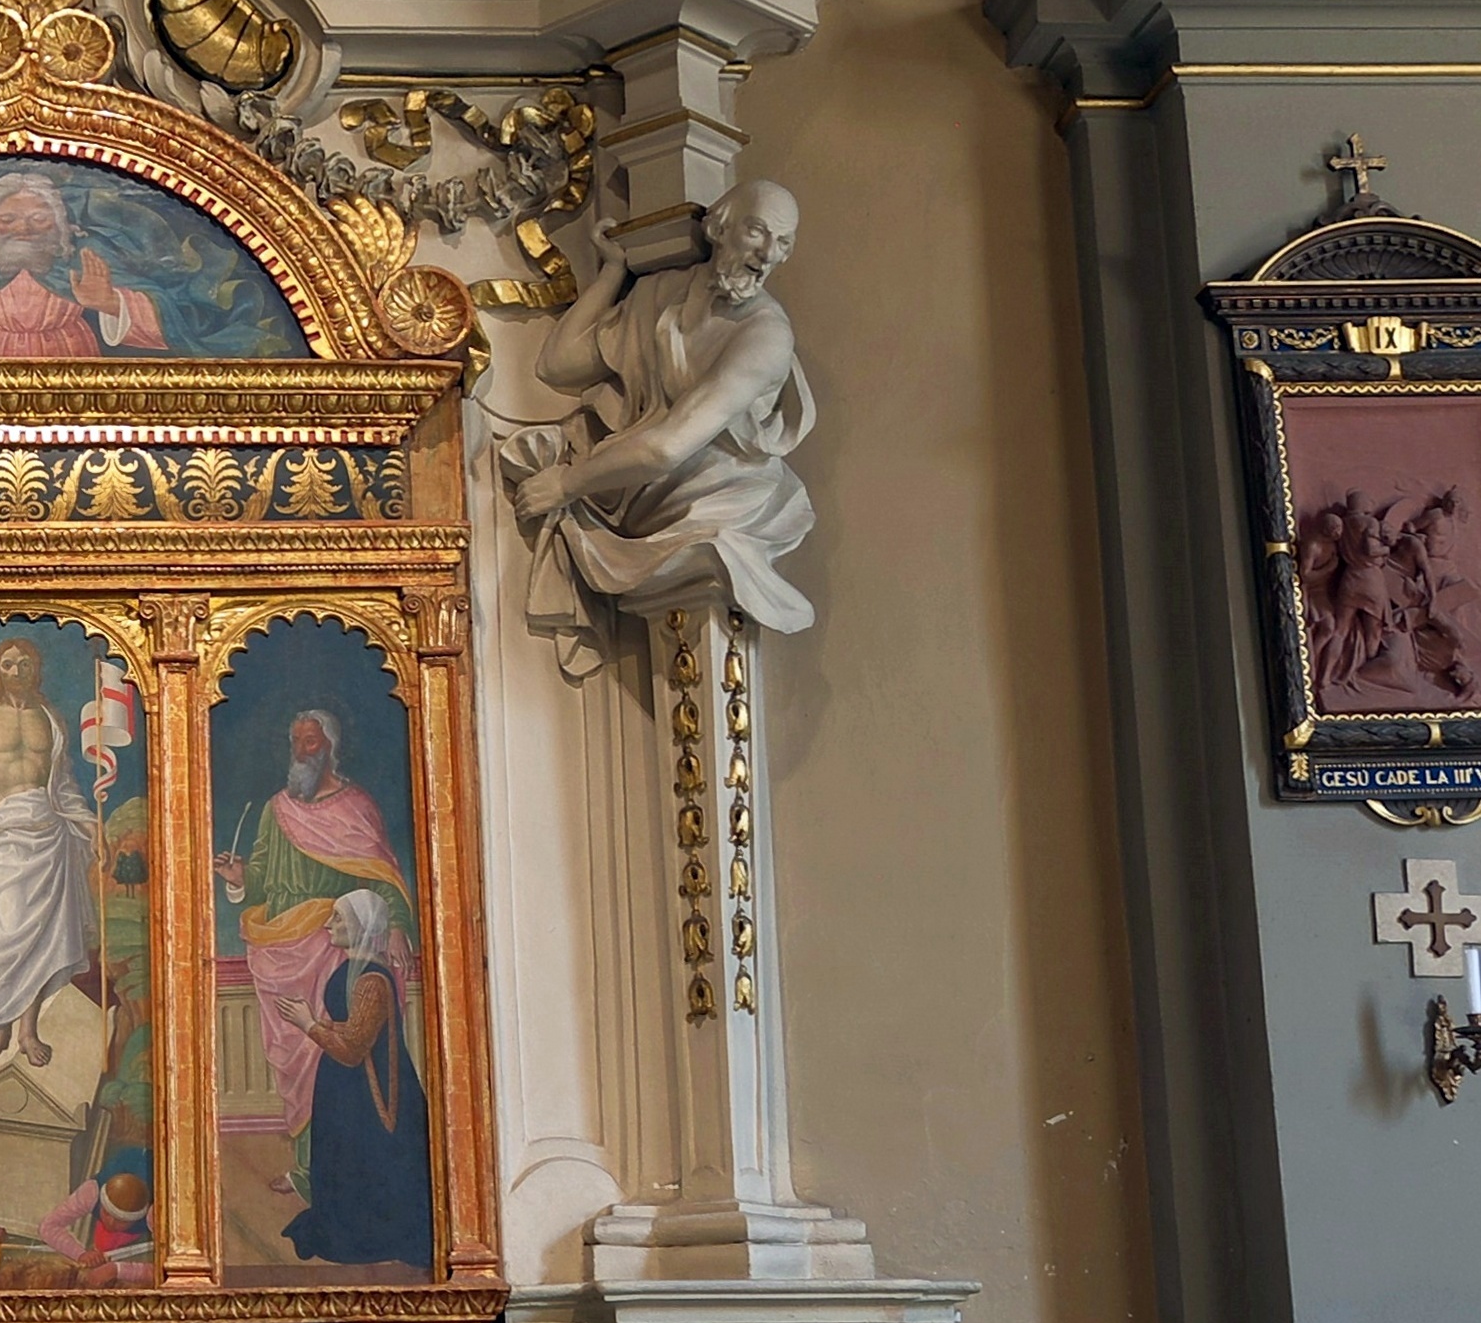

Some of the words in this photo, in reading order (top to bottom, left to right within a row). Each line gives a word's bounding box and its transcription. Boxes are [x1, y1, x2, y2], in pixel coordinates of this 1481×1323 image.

[1373, 326, 1399, 349] IX
[1374, 769, 1422, 785] CADE
[1425, 769, 1450, 785] LA
